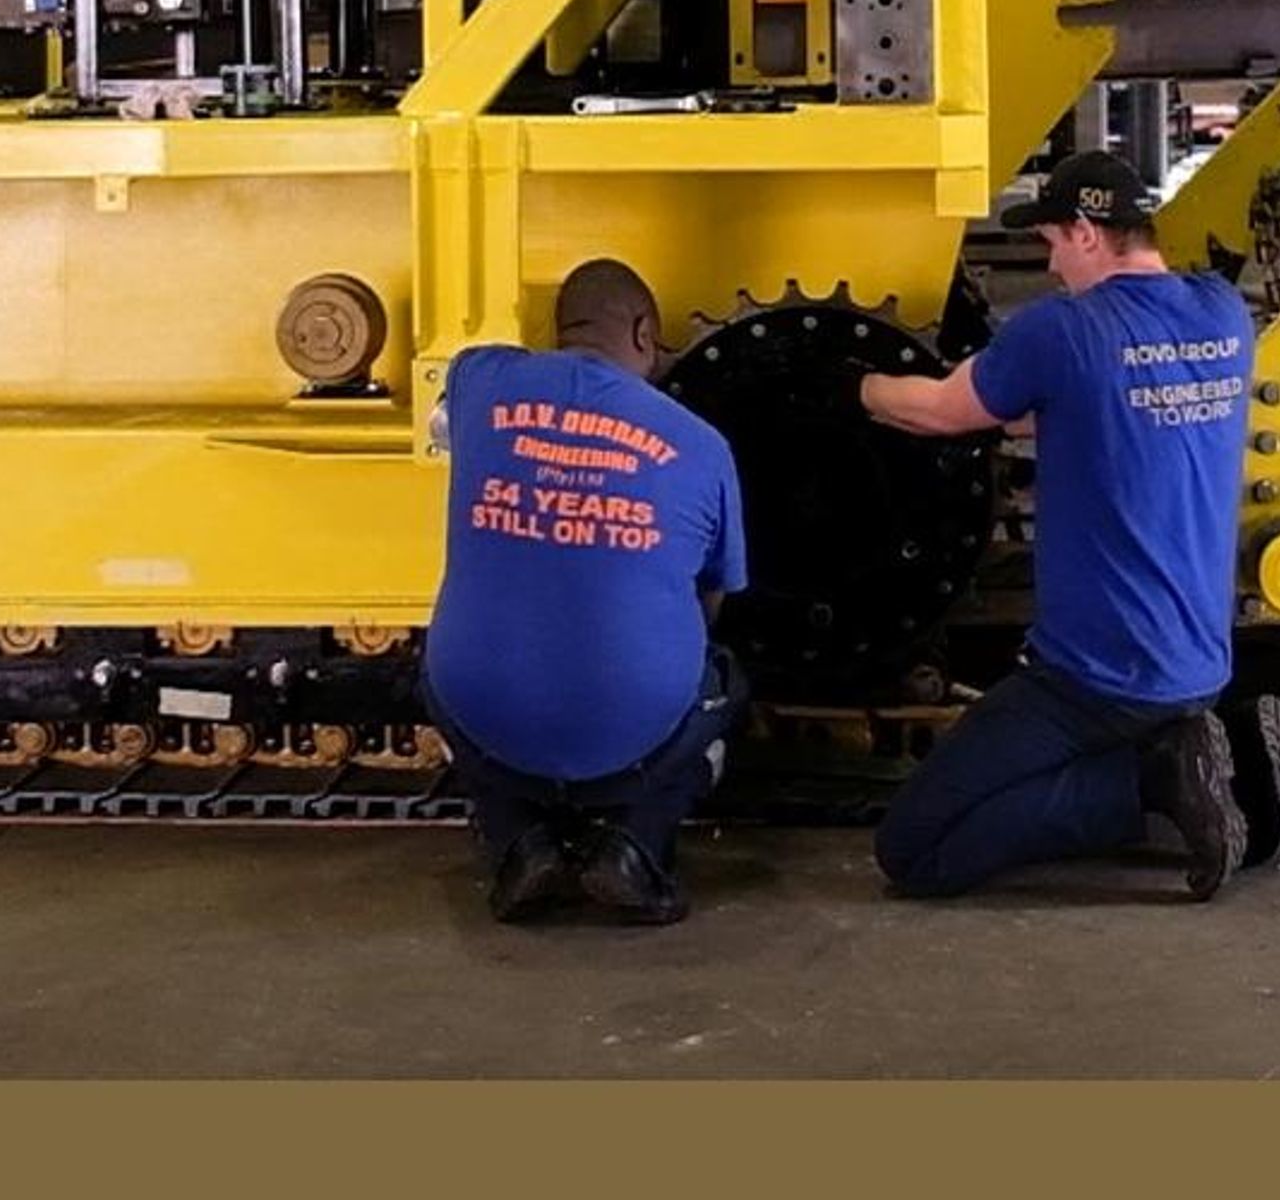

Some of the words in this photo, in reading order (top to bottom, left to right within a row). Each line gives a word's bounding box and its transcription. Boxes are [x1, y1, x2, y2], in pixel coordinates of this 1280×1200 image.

[1179, 337, 1239, 360] GROUP
[1150, 406, 1181, 426] TO
[1181, 400, 1232, 423] WORK
[514, 435, 639, 473] ENGINEERING
[561, 410, 678, 465] DURRANT
[484, 478, 521, 506] 54
[534, 489, 654, 525] YEARS
[472, 504, 545, 540] STILL
[553, 520, 595, 546] ON
[604, 524, 661, 551] TOP
